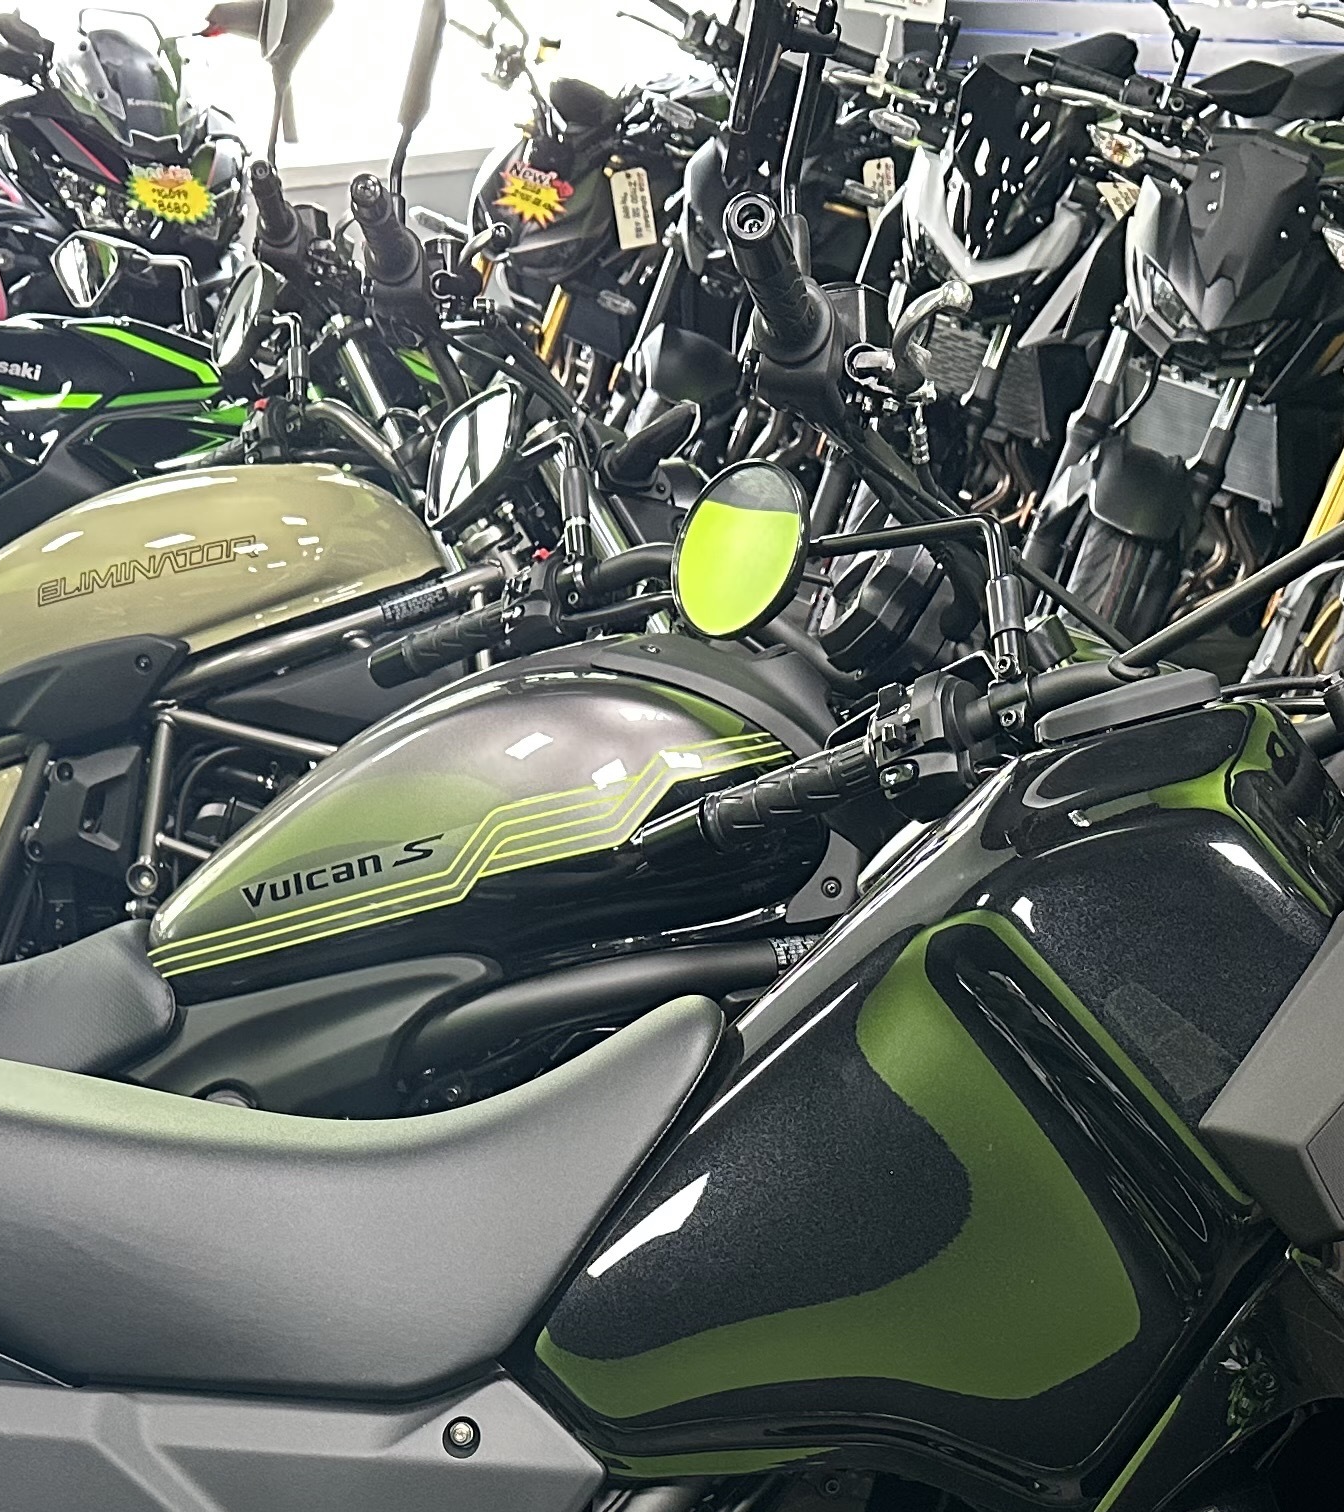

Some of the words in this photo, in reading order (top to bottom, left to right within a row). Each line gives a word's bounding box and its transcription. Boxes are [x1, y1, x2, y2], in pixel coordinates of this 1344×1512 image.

[37, 534, 260, 608] ELIMINATOR
[241, 853, 384, 909] Vulcan
[391, 832, 446, 868] S
